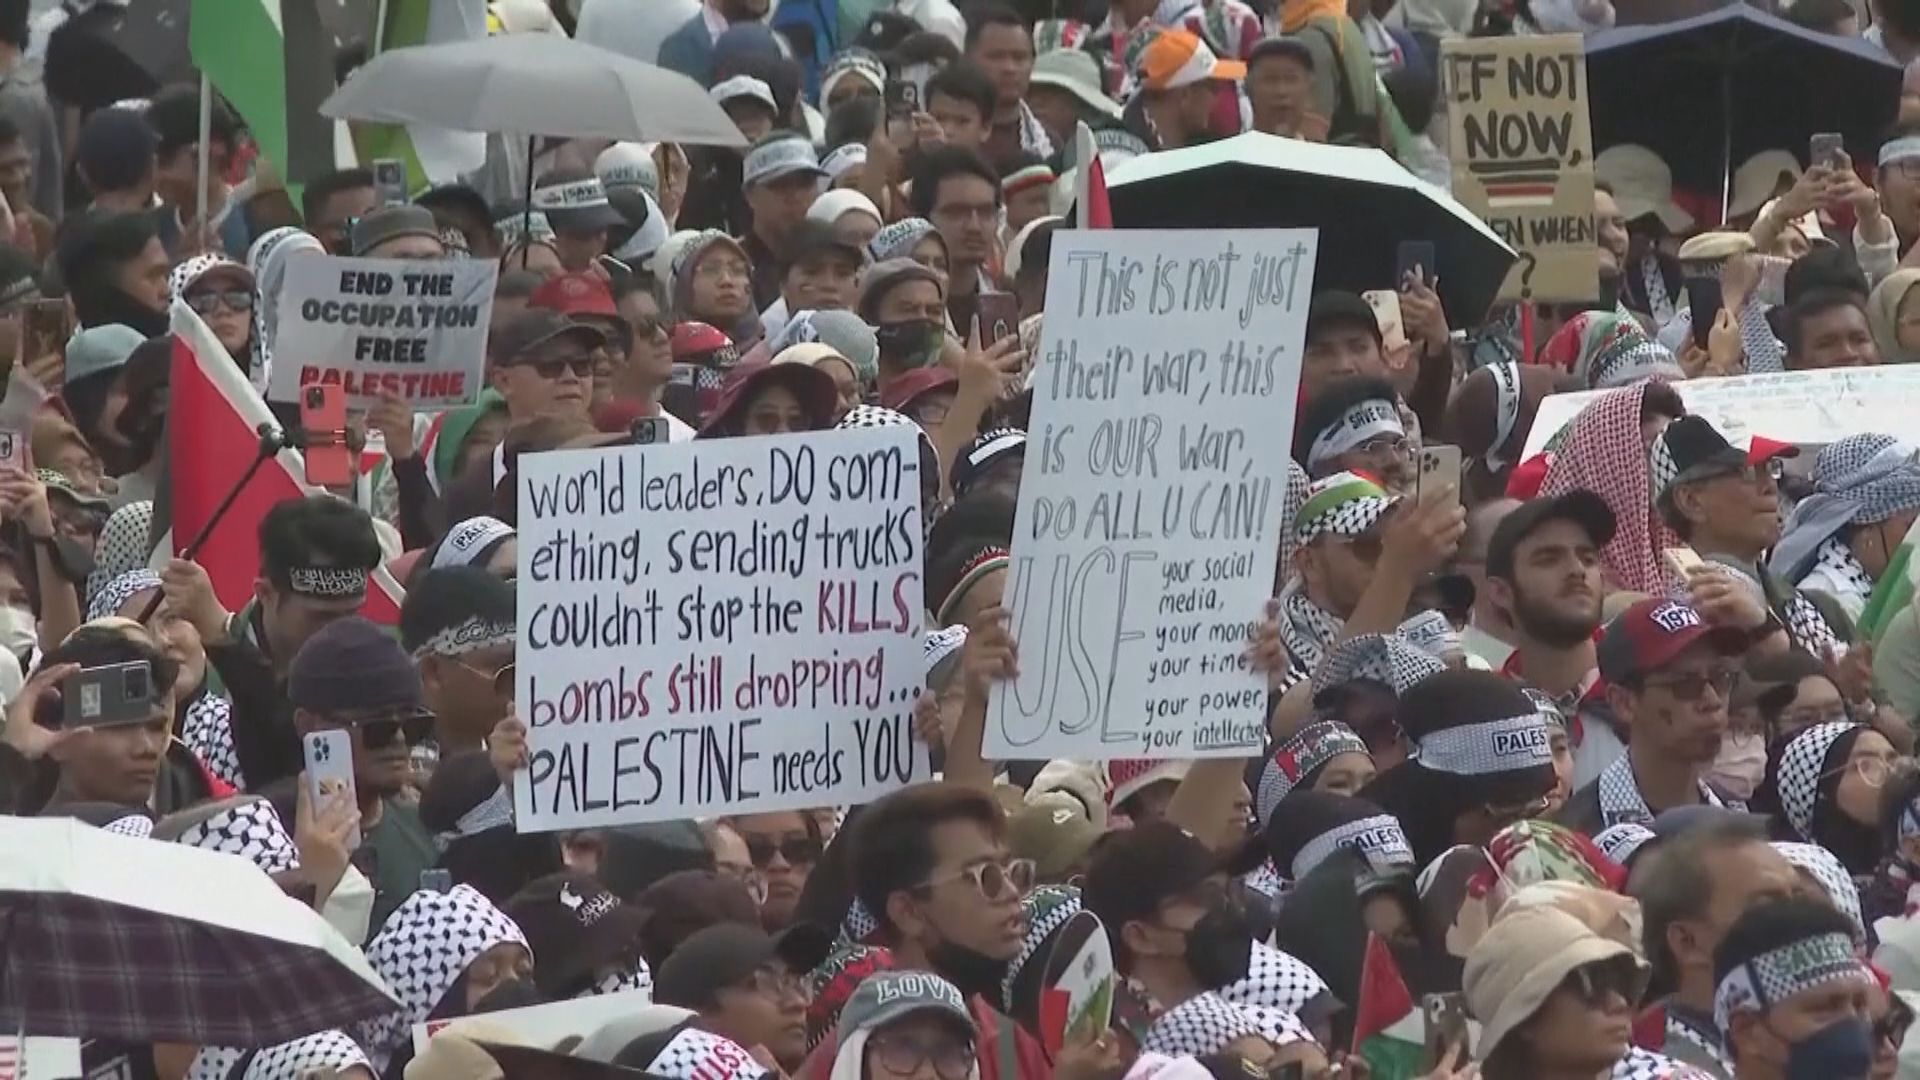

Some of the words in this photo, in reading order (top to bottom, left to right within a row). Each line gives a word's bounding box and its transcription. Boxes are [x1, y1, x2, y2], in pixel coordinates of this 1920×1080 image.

[1451, 53, 1497, 102] IF
[1508, 52, 1576, 101] NOT
[1464, 109, 1581, 166] NOW,
[1484, 216, 1524, 246] EN
[1530, 215, 1595, 246] WHEN
[340, 271, 393, 296] END
[404, 274, 453, 297] THE
[1068, 249, 1143, 318] This
[1150, 253, 1178, 315] is
[1184, 240, 1240, 313] not
[1239, 240, 1307, 330] just
[1519, 251, 1536, 298] ?
[302, 299, 478, 328] OCCUPATION
[355, 336, 428, 363] FREE
[1046, 339, 1134, 401] their
[1143, 347, 1212, 405] war,
[1220, 340, 1285, 397] this
[301, 365, 465, 397] PALESTINE
[1348, 405, 1378, 430] SAVE
[1040, 421, 1075, 475] is
[1088, 412, 1163, 479] OUR
[770, 445, 815, 504] DO
[829, 446, 916, 502] som-
[1032, 495, 1077, 541] DO
[1084, 489, 1152, 541] ALL
[1162, 484, 1183, 540] U
[1190, 476, 1271, 543] CAN!
[530, 529, 652, 583] ething,
[668, 513, 810, 578] sending
[816, 506, 916, 569] trucks
[1161, 562, 1195, 590] your
[1202, 551, 1254, 580] social
[528, 592, 663, 650] couldn't
[677, 584, 742, 645] stop
[750, 588, 802, 635] the
[818, 573, 921, 639] KILLS,
[1159, 588, 1224, 615] media,
[1001, 546, 1158, 747] USE
[1156, 622, 1202, 651] your
[530, 666, 652, 727] bombs
[668, 653, 722, 714] still
[736, 647, 921, 711] dropping...
[1148, 656, 1192, 684] your
[1145, 695, 1189, 726] your
[1200, 687, 1264, 717] power,
[1142, 727, 1183, 752] your
[528, 718, 762, 815] PALESTINE
[773, 722, 844, 794] needs
[853, 712, 914, 786] YOU
